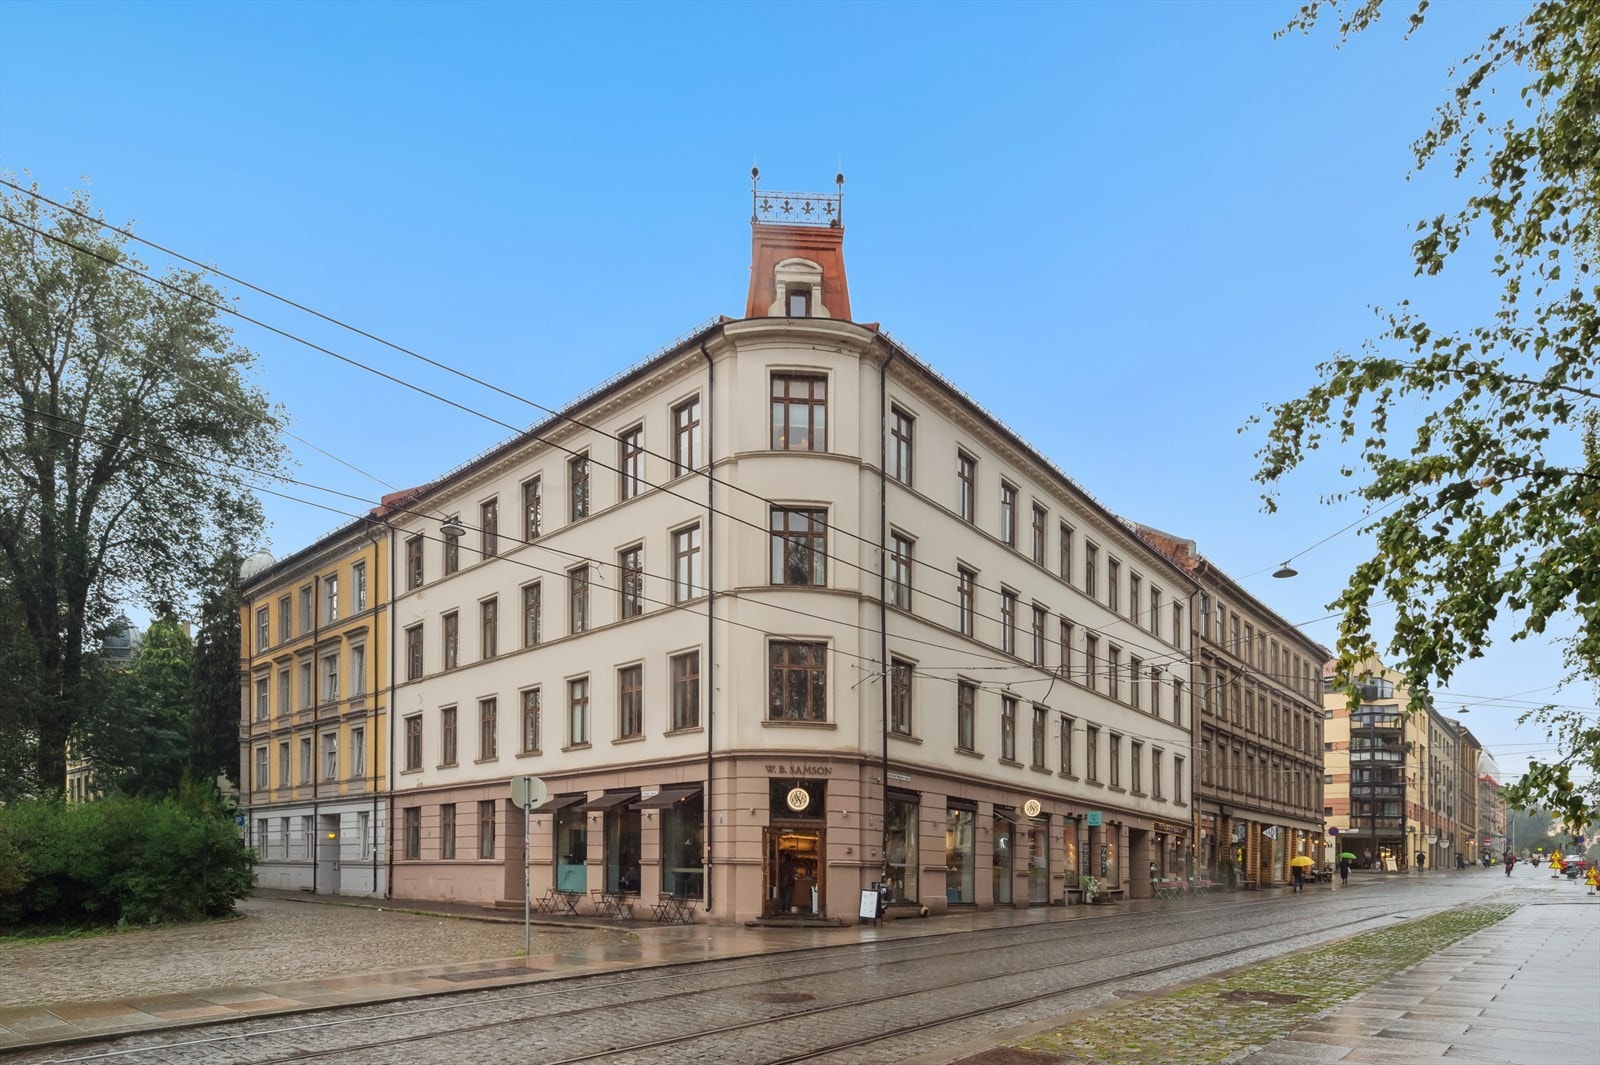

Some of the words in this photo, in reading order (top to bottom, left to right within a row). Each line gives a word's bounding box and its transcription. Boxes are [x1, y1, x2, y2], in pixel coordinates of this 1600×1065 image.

[764, 765, 777, 774] W.
[779, 765, 788, 774] B.
[789, 766, 832, 776] SAMSON
